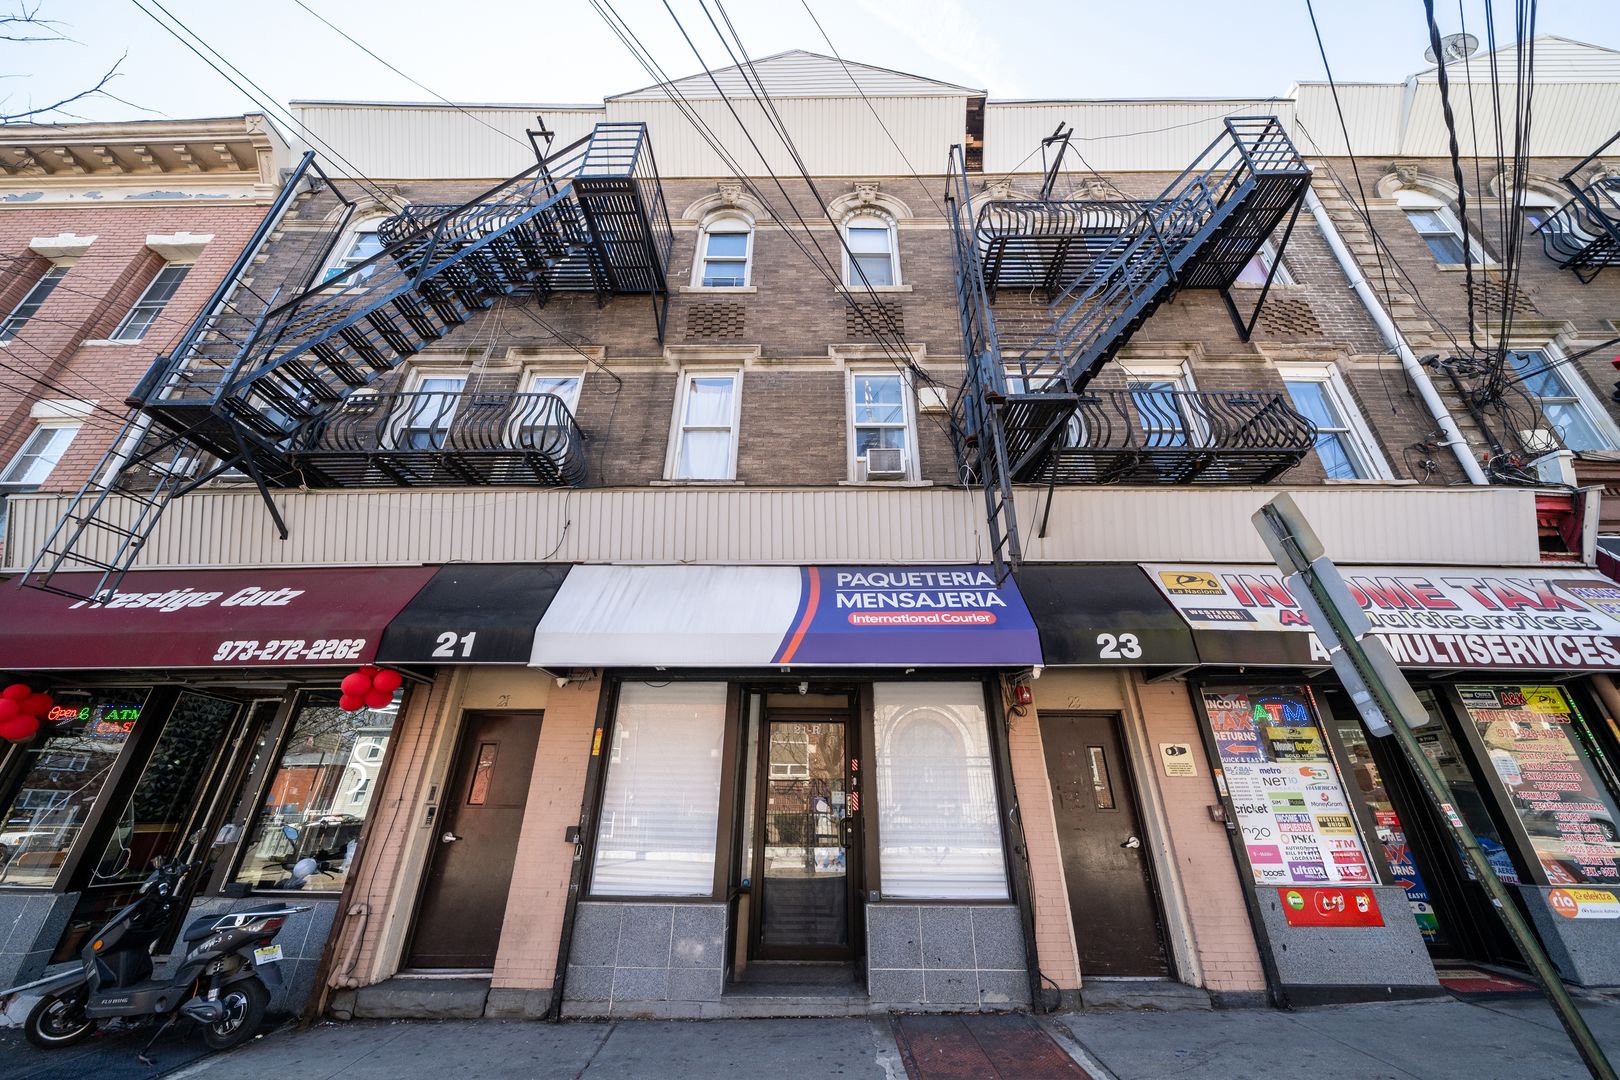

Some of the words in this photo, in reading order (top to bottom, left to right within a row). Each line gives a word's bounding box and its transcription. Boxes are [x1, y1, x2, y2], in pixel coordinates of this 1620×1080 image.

[837, 571, 996, 588] PAQUETERIA
[220, 586, 305, 607] Cutz
[836, 591, 1007, 609] MENSAJERIA
[1440, 577, 1591, 613] TAX
[853, 613, 940, 624] International
[942, 613, 990, 623] Courier
[213, 638, 366, 661] 973-272-2262
[431, 631, 477, 657] 21
[1096, 633, 1143, 659] 23
[1205, 700, 1248, 709] INCOME
[47, 705, 77, 720] Open
[1253, 703, 1308, 722] ATM
[1208, 710, 1254, 731] TAX
[794, 724, 821, 735] 21-R
[1214, 731, 1257, 741] RETURNS
[1235, 803, 1269, 814] cricket
[1276, 814, 1298, 823] INCOME
[1299, 814, 1310, 823] TAX
[1279, 822, 1314, 832] IMPUESTOS
[1291, 834, 1317, 844] PSEG
[1263, 869, 1286, 877] boost
[1552, 891, 1575, 907] ria
[1583, 891, 1612, 900] elektra
